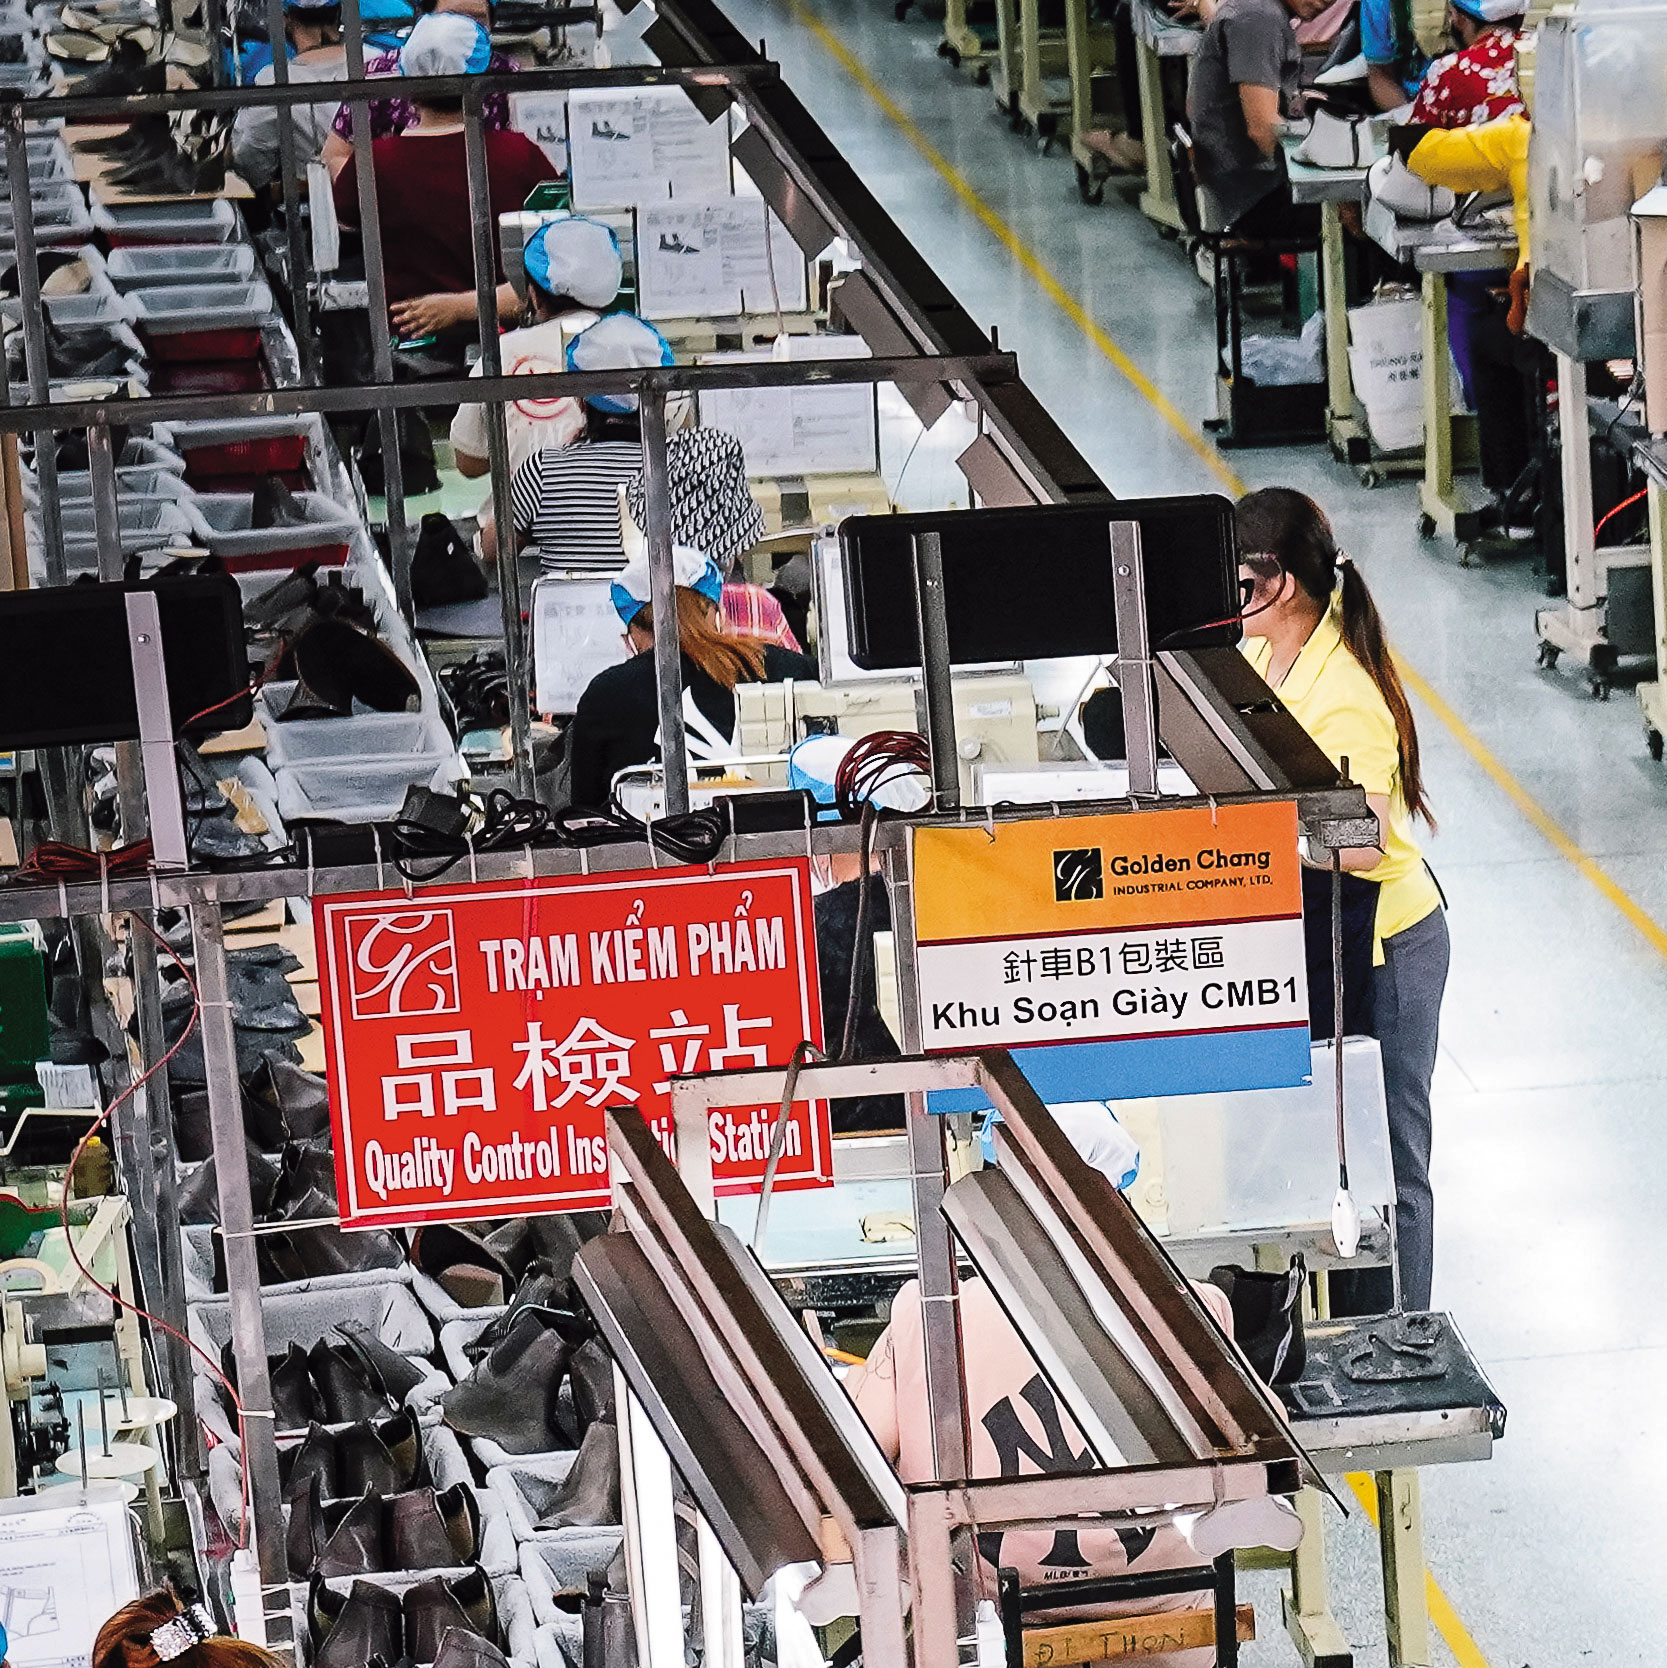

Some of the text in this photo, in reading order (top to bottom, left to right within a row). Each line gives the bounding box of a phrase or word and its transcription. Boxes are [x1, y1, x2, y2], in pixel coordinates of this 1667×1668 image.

[1110, 847, 1272, 877] Golden Chang
[1113, 881, 1184, 896] INDUSTRIAL
[479, 889, 787, 1001] TRẠM KIỂM PHẨM
[1002, 935, 1225, 984] 針車B1包裝區
[932, 976, 1298, 1030] Khu Soạn Giày CMB1
[364, 1131, 455, 1202] Quality
[463, 1125, 562, 1185] Control
